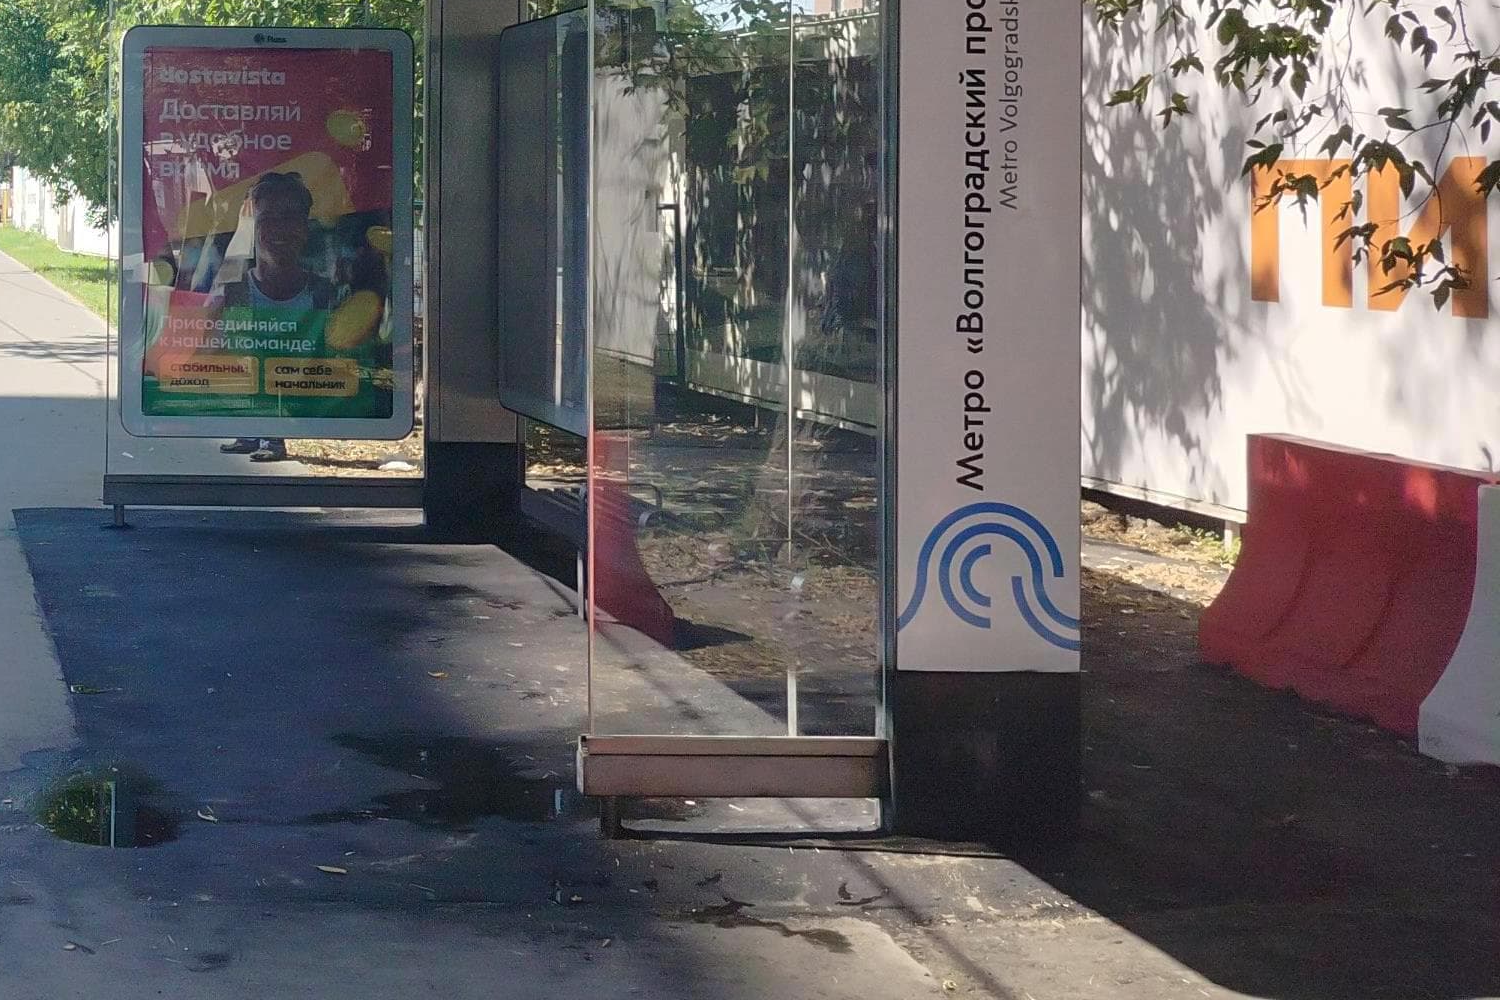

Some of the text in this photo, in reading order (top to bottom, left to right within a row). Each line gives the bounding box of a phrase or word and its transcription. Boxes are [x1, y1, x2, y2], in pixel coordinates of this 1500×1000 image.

[158, 98, 300, 123] Доставляй
[999, 140, 1018, 210] Metro
[956, 69, 992, 355] «Волгоградский
[161, 315, 297, 333] Присоединяйся
[171, 333, 232, 349] нашей
[235, 336, 316, 352] команде:
[274, 364, 333, 376] сам себе
[274, 379, 346, 391] начальник
[956, 369, 992, 491] Метро
